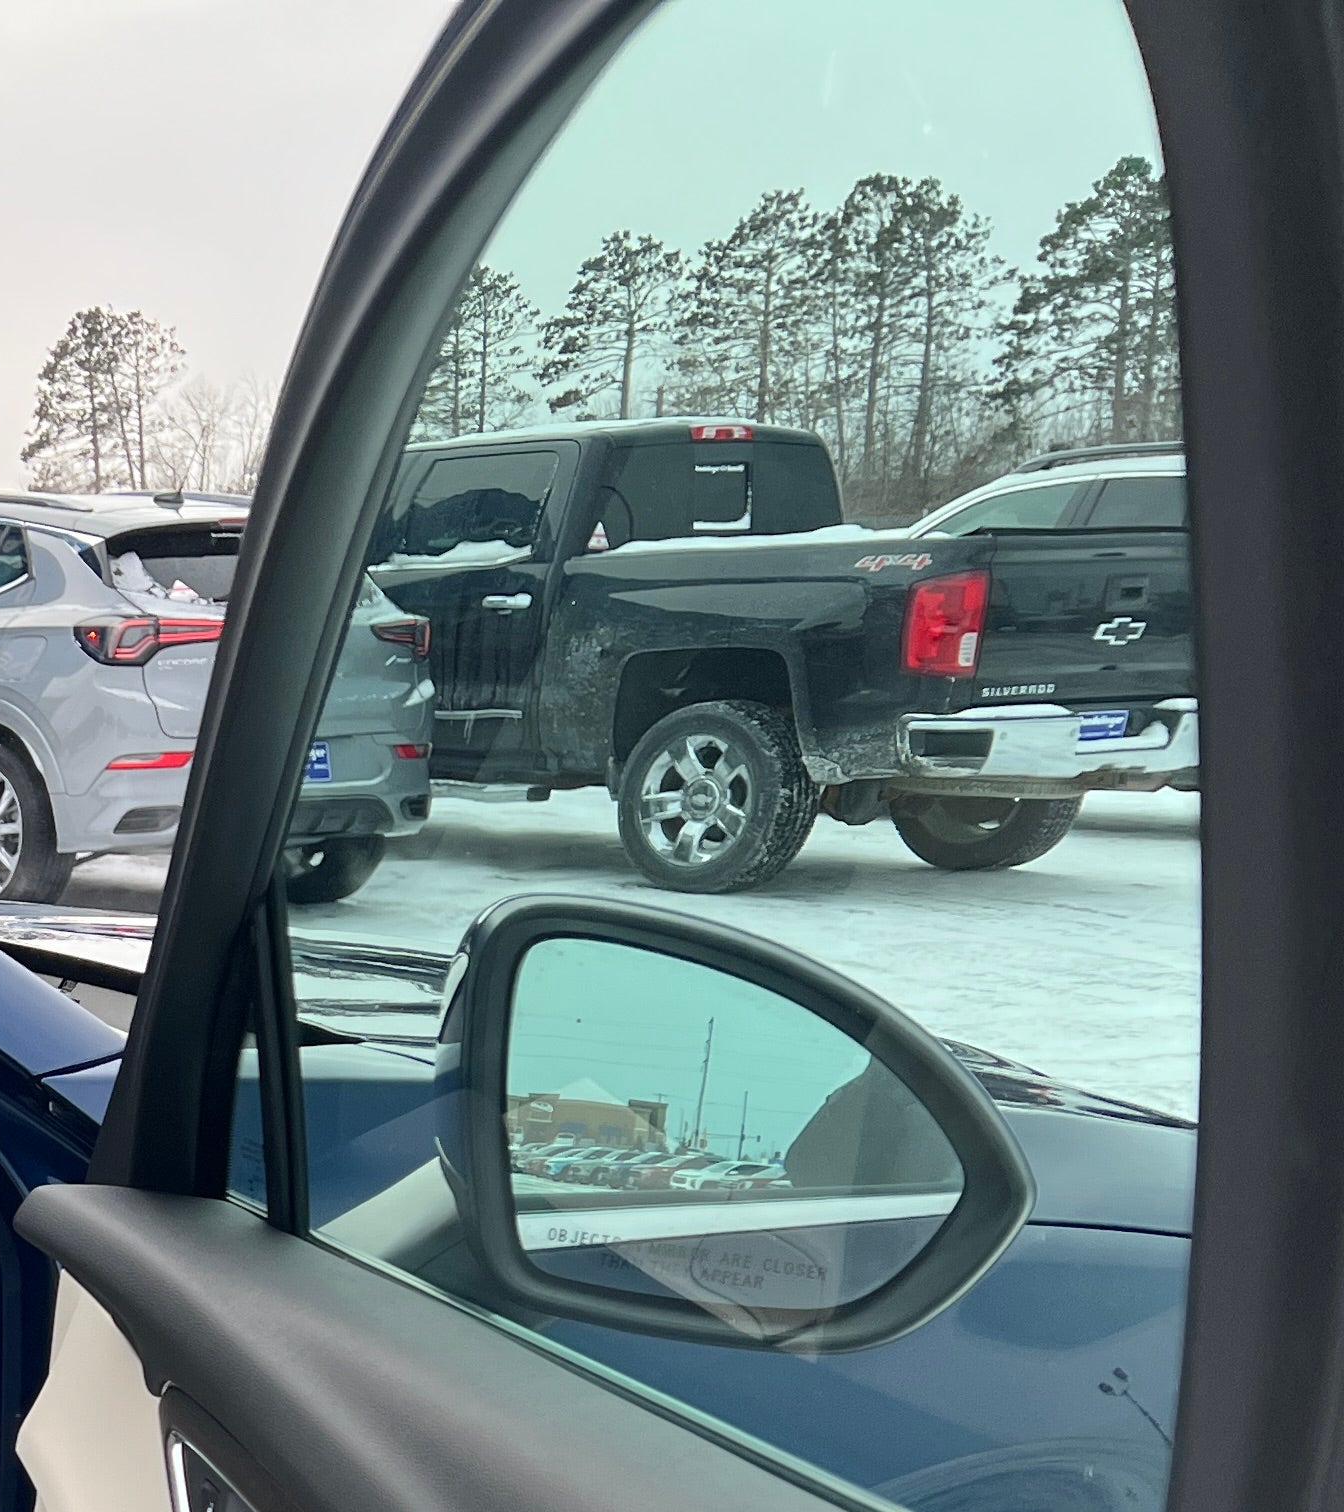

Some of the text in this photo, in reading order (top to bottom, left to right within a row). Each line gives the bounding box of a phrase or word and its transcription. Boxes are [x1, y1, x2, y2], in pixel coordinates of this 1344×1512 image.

[981, 683, 1055, 697] SILVERADO
[699, 1266, 765, 1290] APPEAR
[720, 1254, 753, 1269] ARE
[762, 1258, 828, 1281] CLOSER
